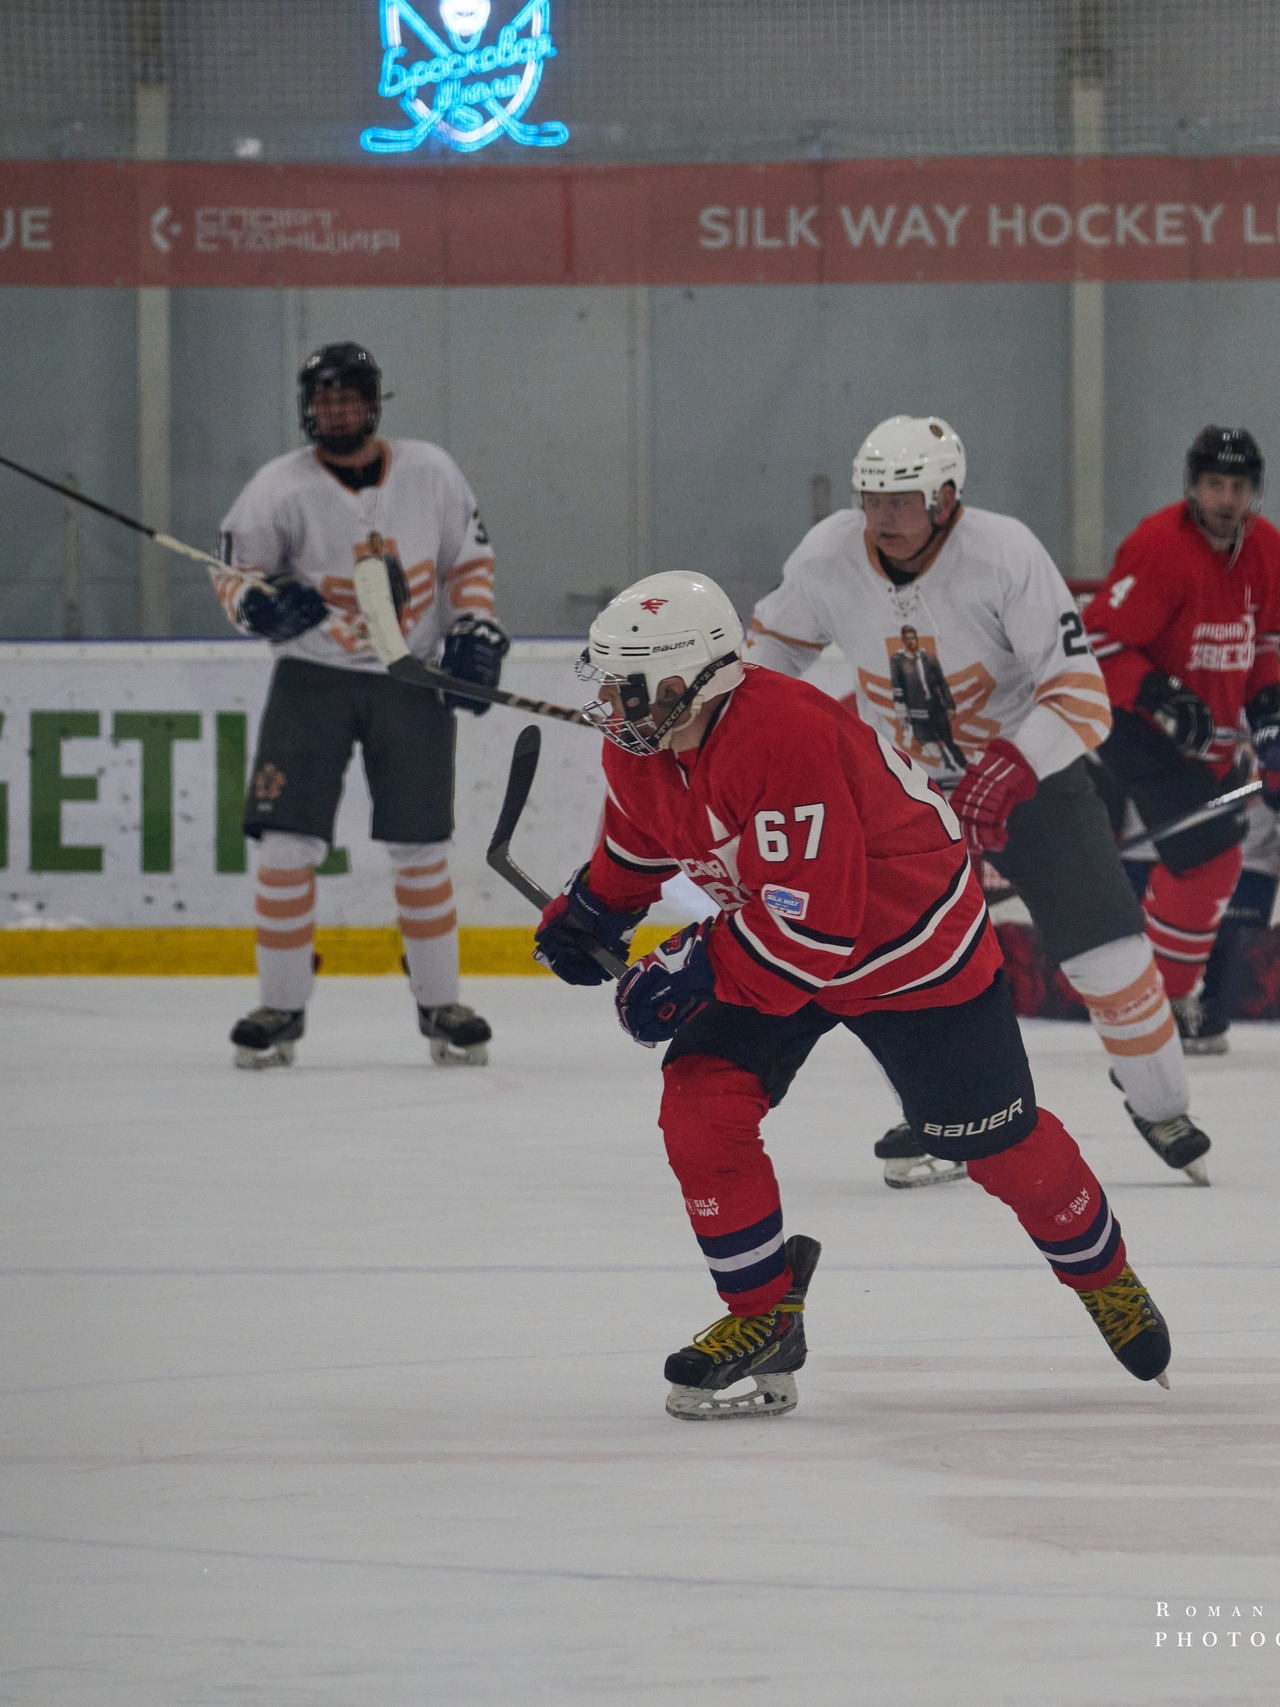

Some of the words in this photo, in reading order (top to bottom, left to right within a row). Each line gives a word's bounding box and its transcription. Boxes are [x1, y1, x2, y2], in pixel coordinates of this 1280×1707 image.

[698, 205, 822, 249] SILK
[838, 204, 970, 248] WAY
[986, 203, 1224, 248] HOCKEY
[753, 801, 826, 863] 67
[922, 1097, 1024, 1138] BAUER
[693, 1197, 719, 1208] SILK
[696, 1206, 720, 1217] WAY
[1069, 1187, 1088, 1212] SILK
[1074, 1192, 1091, 1215] WAY
